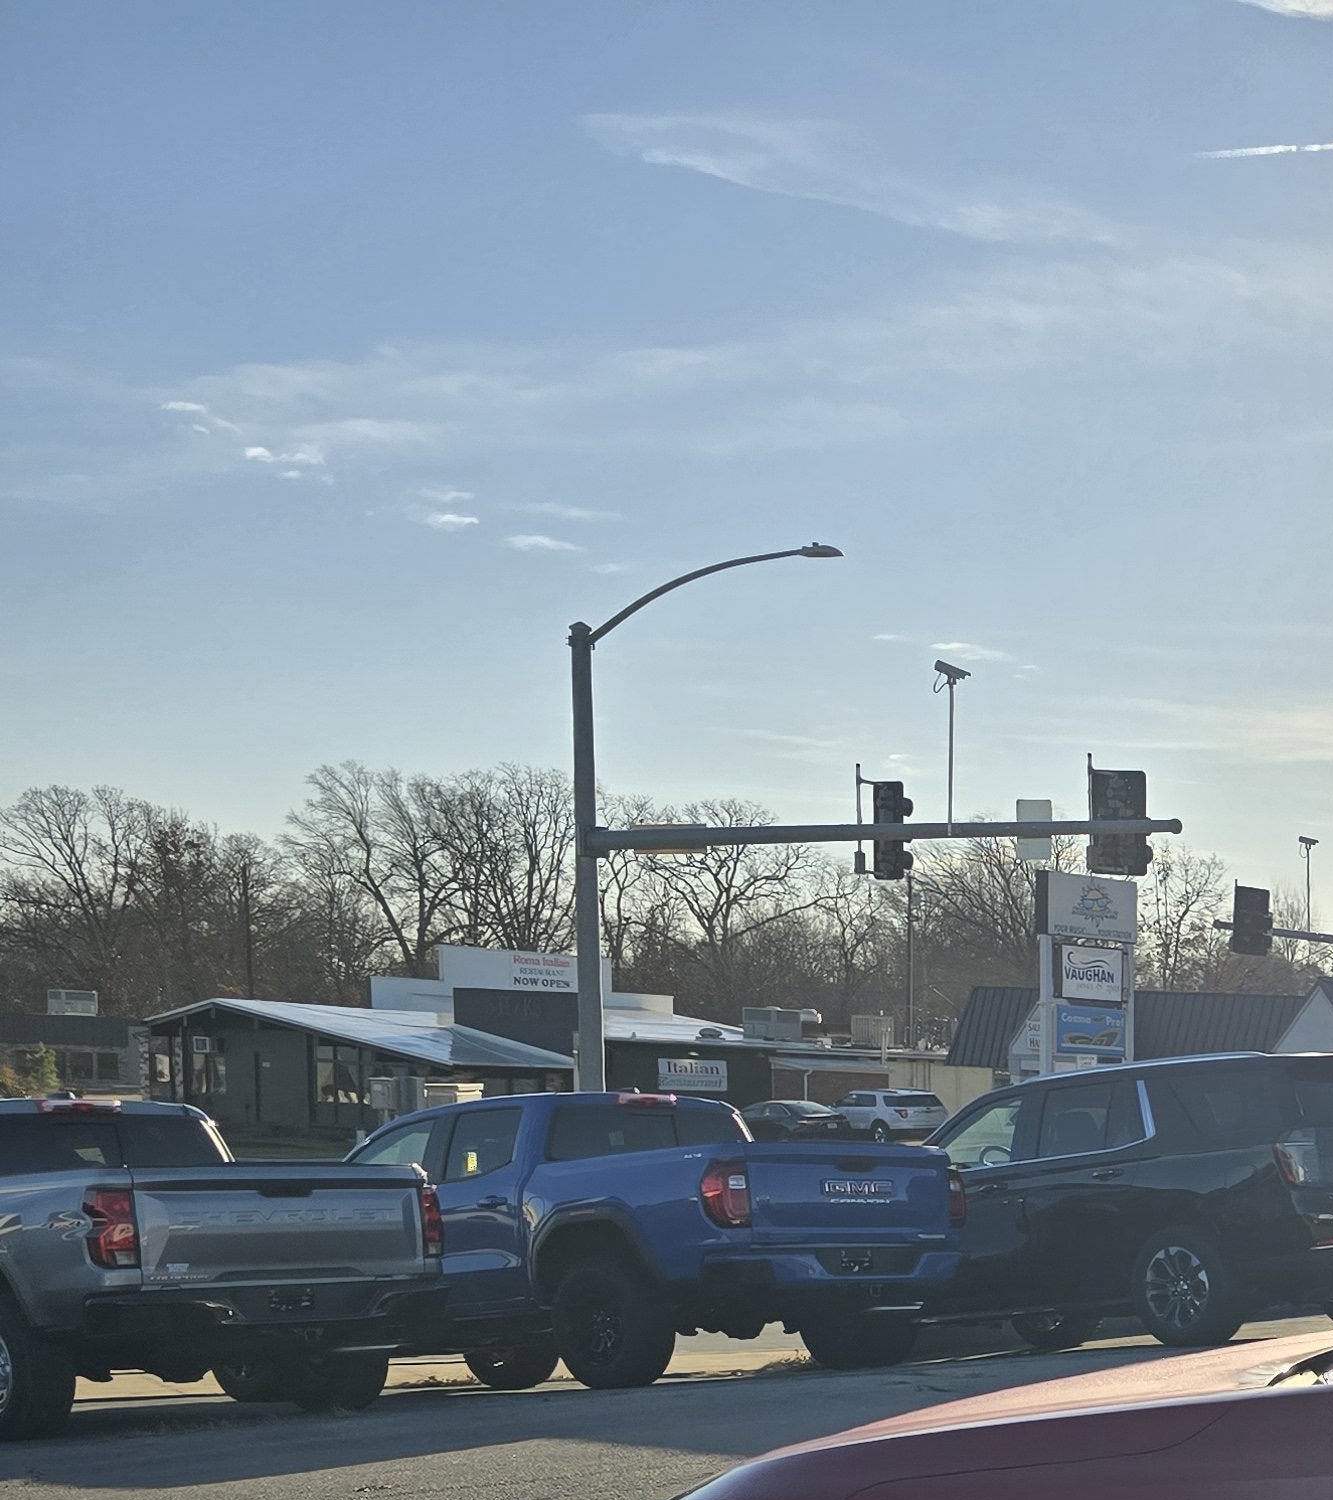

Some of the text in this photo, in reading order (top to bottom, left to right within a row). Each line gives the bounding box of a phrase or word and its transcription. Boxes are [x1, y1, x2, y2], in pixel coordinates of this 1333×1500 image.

[1064, 965, 1115, 983] VAUGHAN
[513, 977, 570, 988] NOW OPEN
[666, 1061, 720, 1075] Italian
[823, 1179, 894, 1195] GMC
[173, 1208, 397, 1226] CHEVROLET
